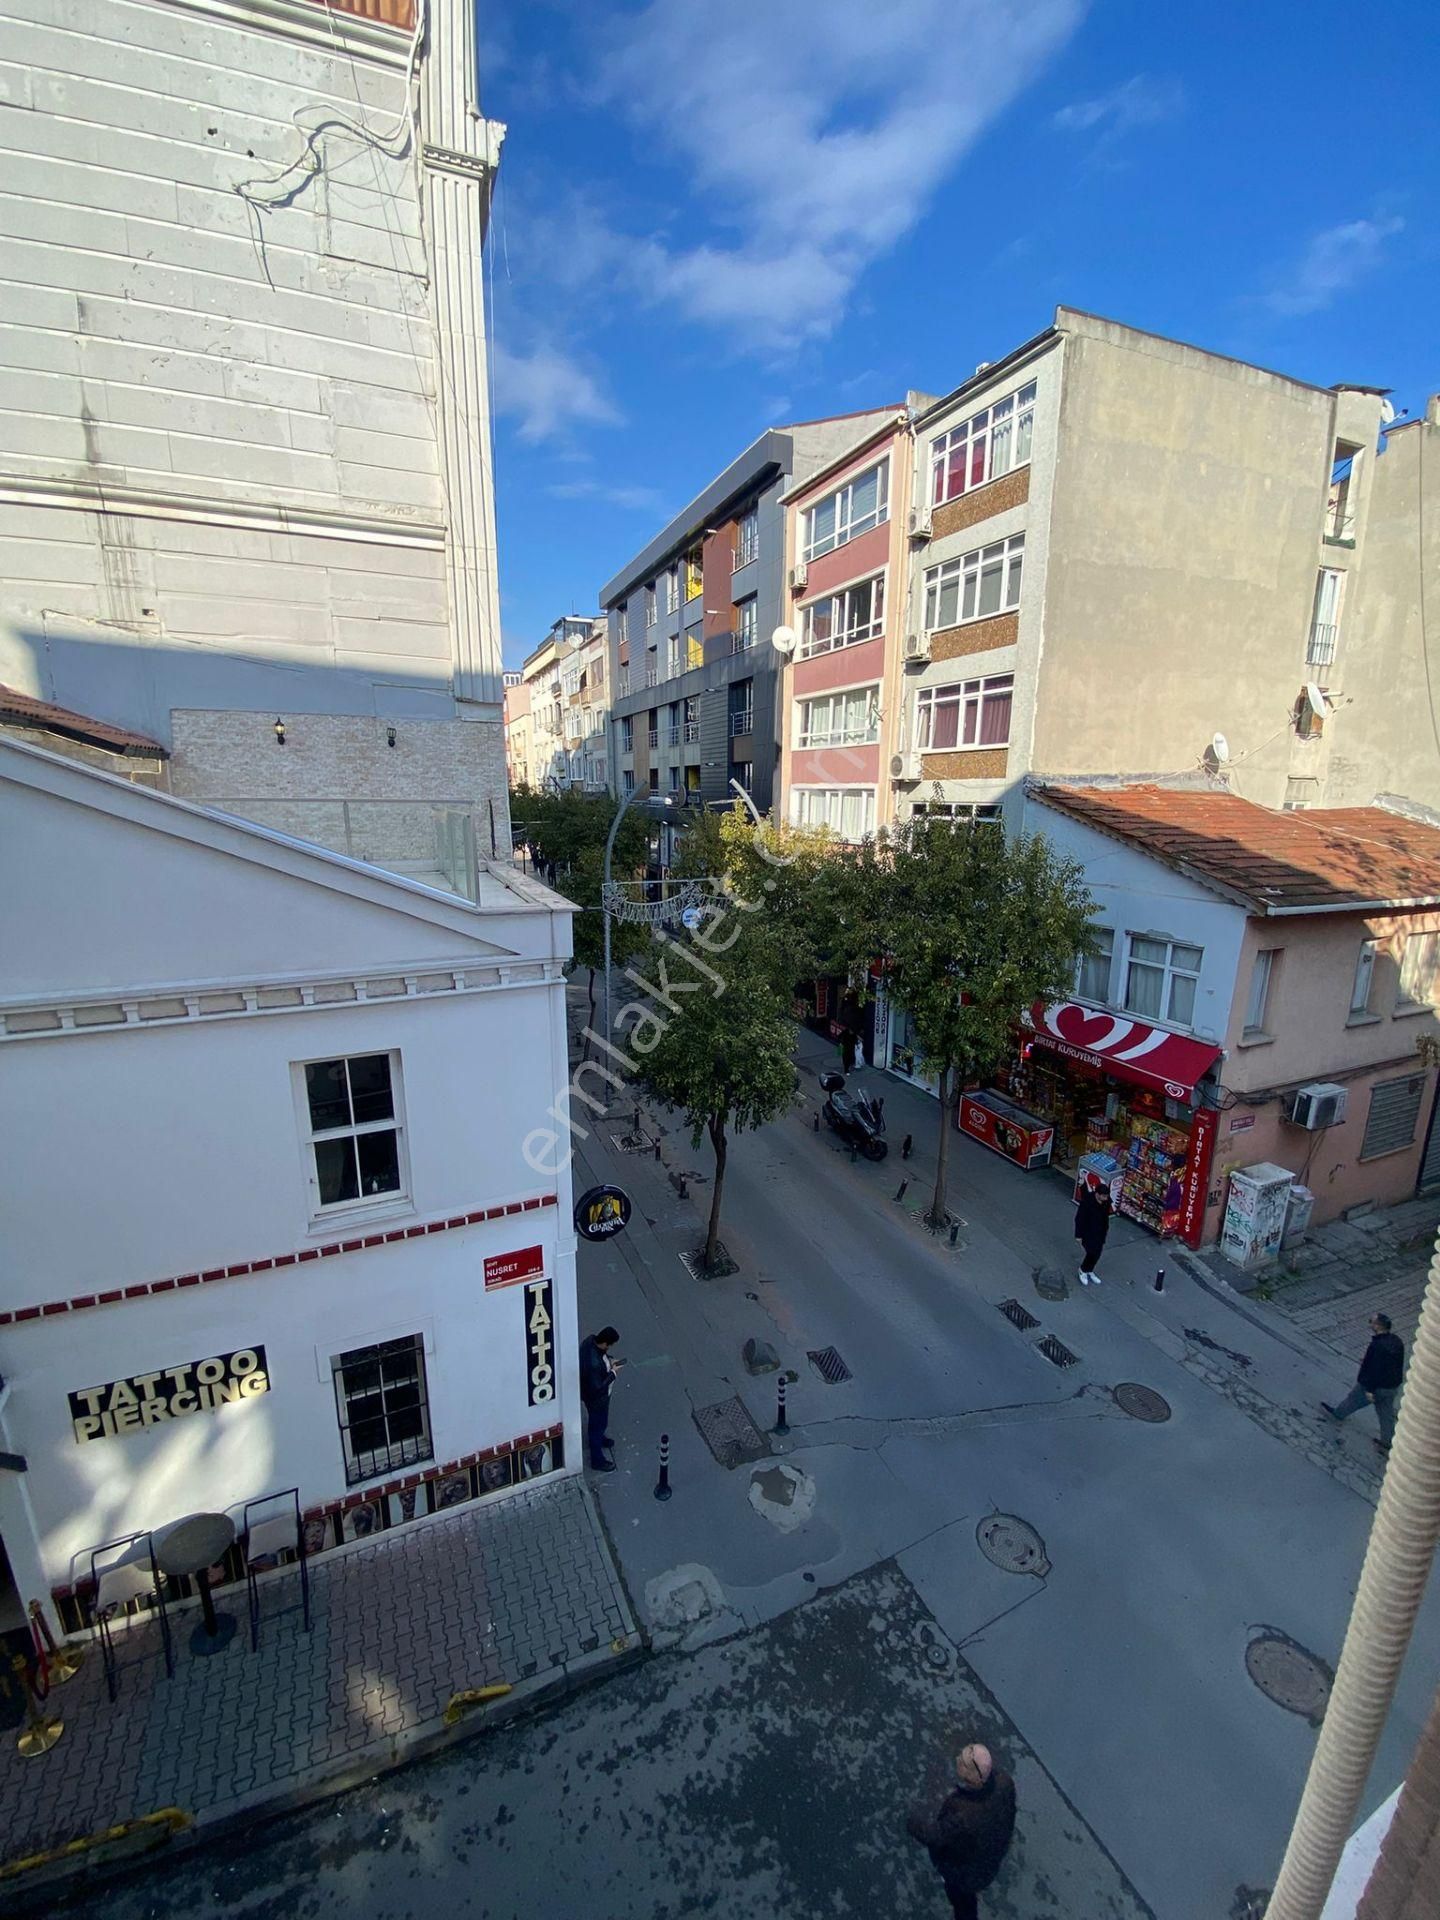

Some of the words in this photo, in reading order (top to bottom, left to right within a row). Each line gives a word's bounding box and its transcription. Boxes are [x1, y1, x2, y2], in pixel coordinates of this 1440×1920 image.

[486, 1262, 519, 1278] NUSRET
[528, 1280, 554, 1405] TATTOO
[74, 1370, 268, 1444] PIERCING
[77, 1349, 258, 1416] TATTOO
